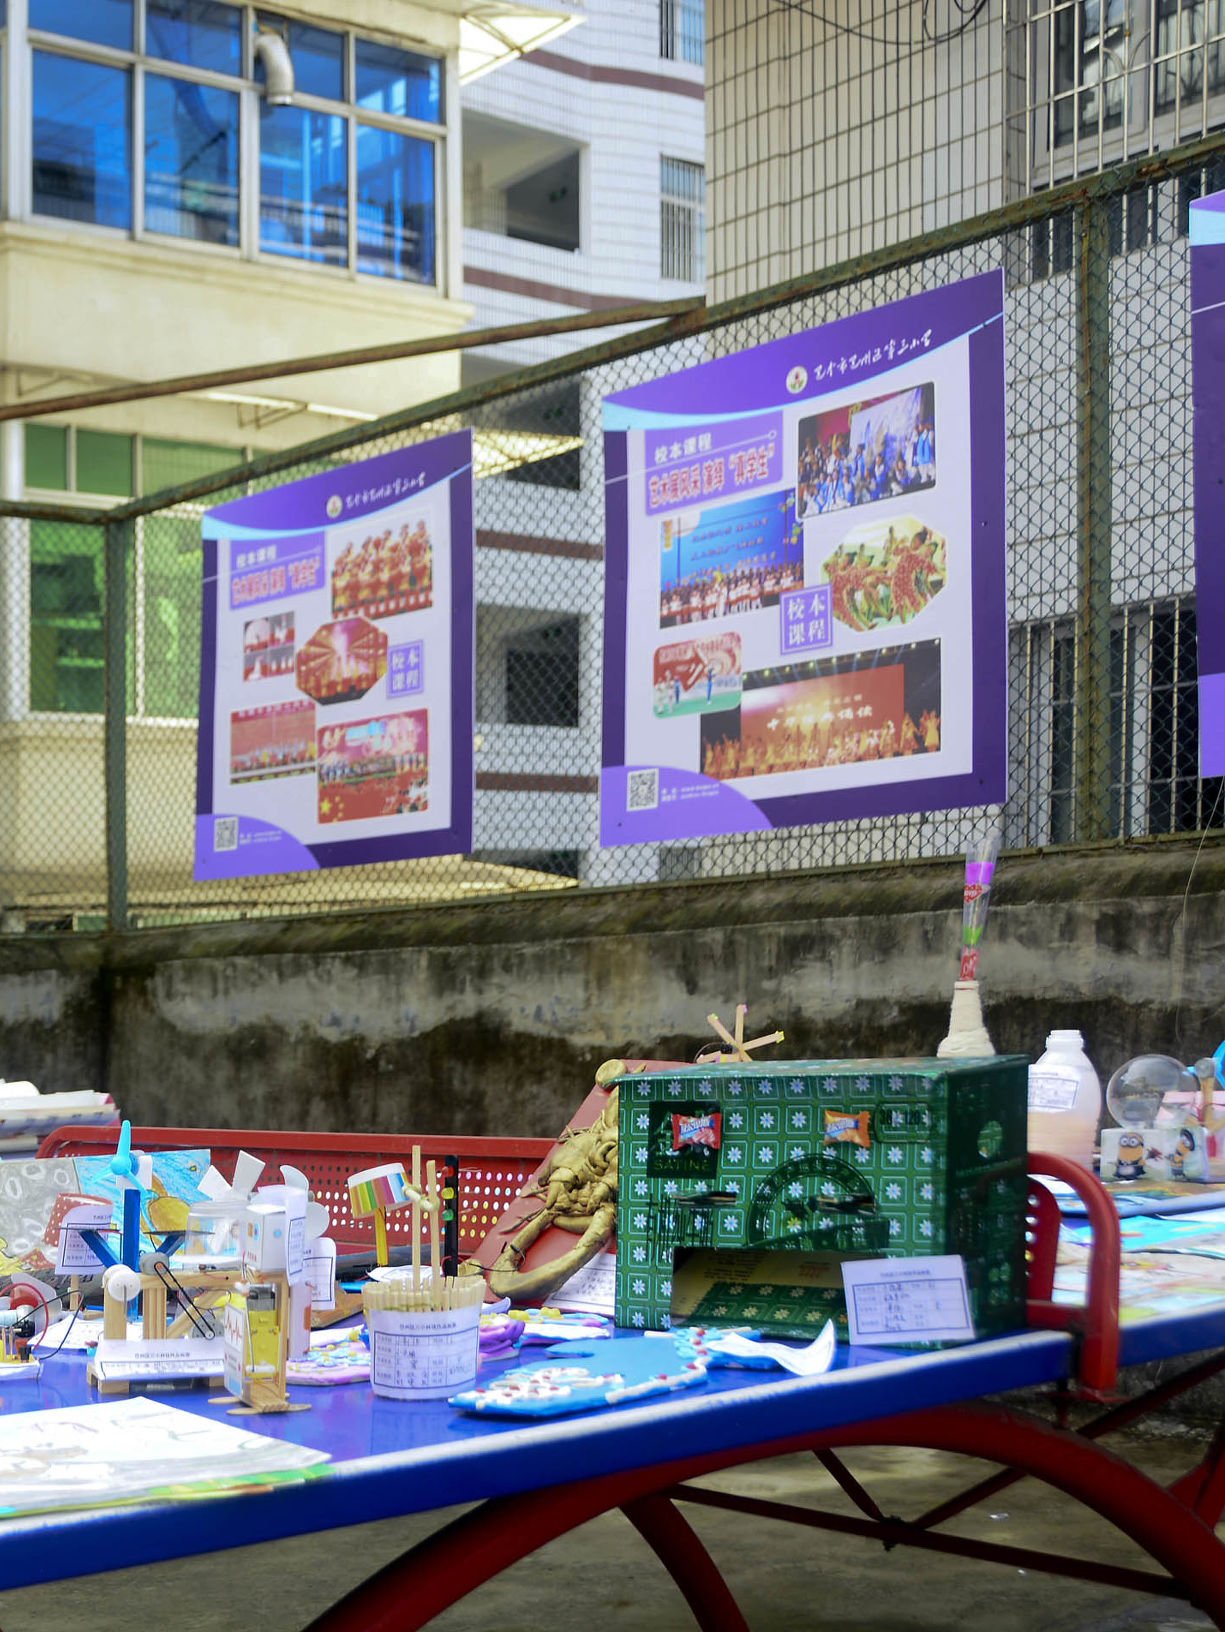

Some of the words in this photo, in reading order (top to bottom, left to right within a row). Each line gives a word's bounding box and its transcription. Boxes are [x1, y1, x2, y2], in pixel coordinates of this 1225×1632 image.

[655, 432, 712, 464] 校本课程
[786, 594, 826, 622] 校本
[787, 619, 826, 647] 课程
[655, 1159, 709, 1170] SATINE
